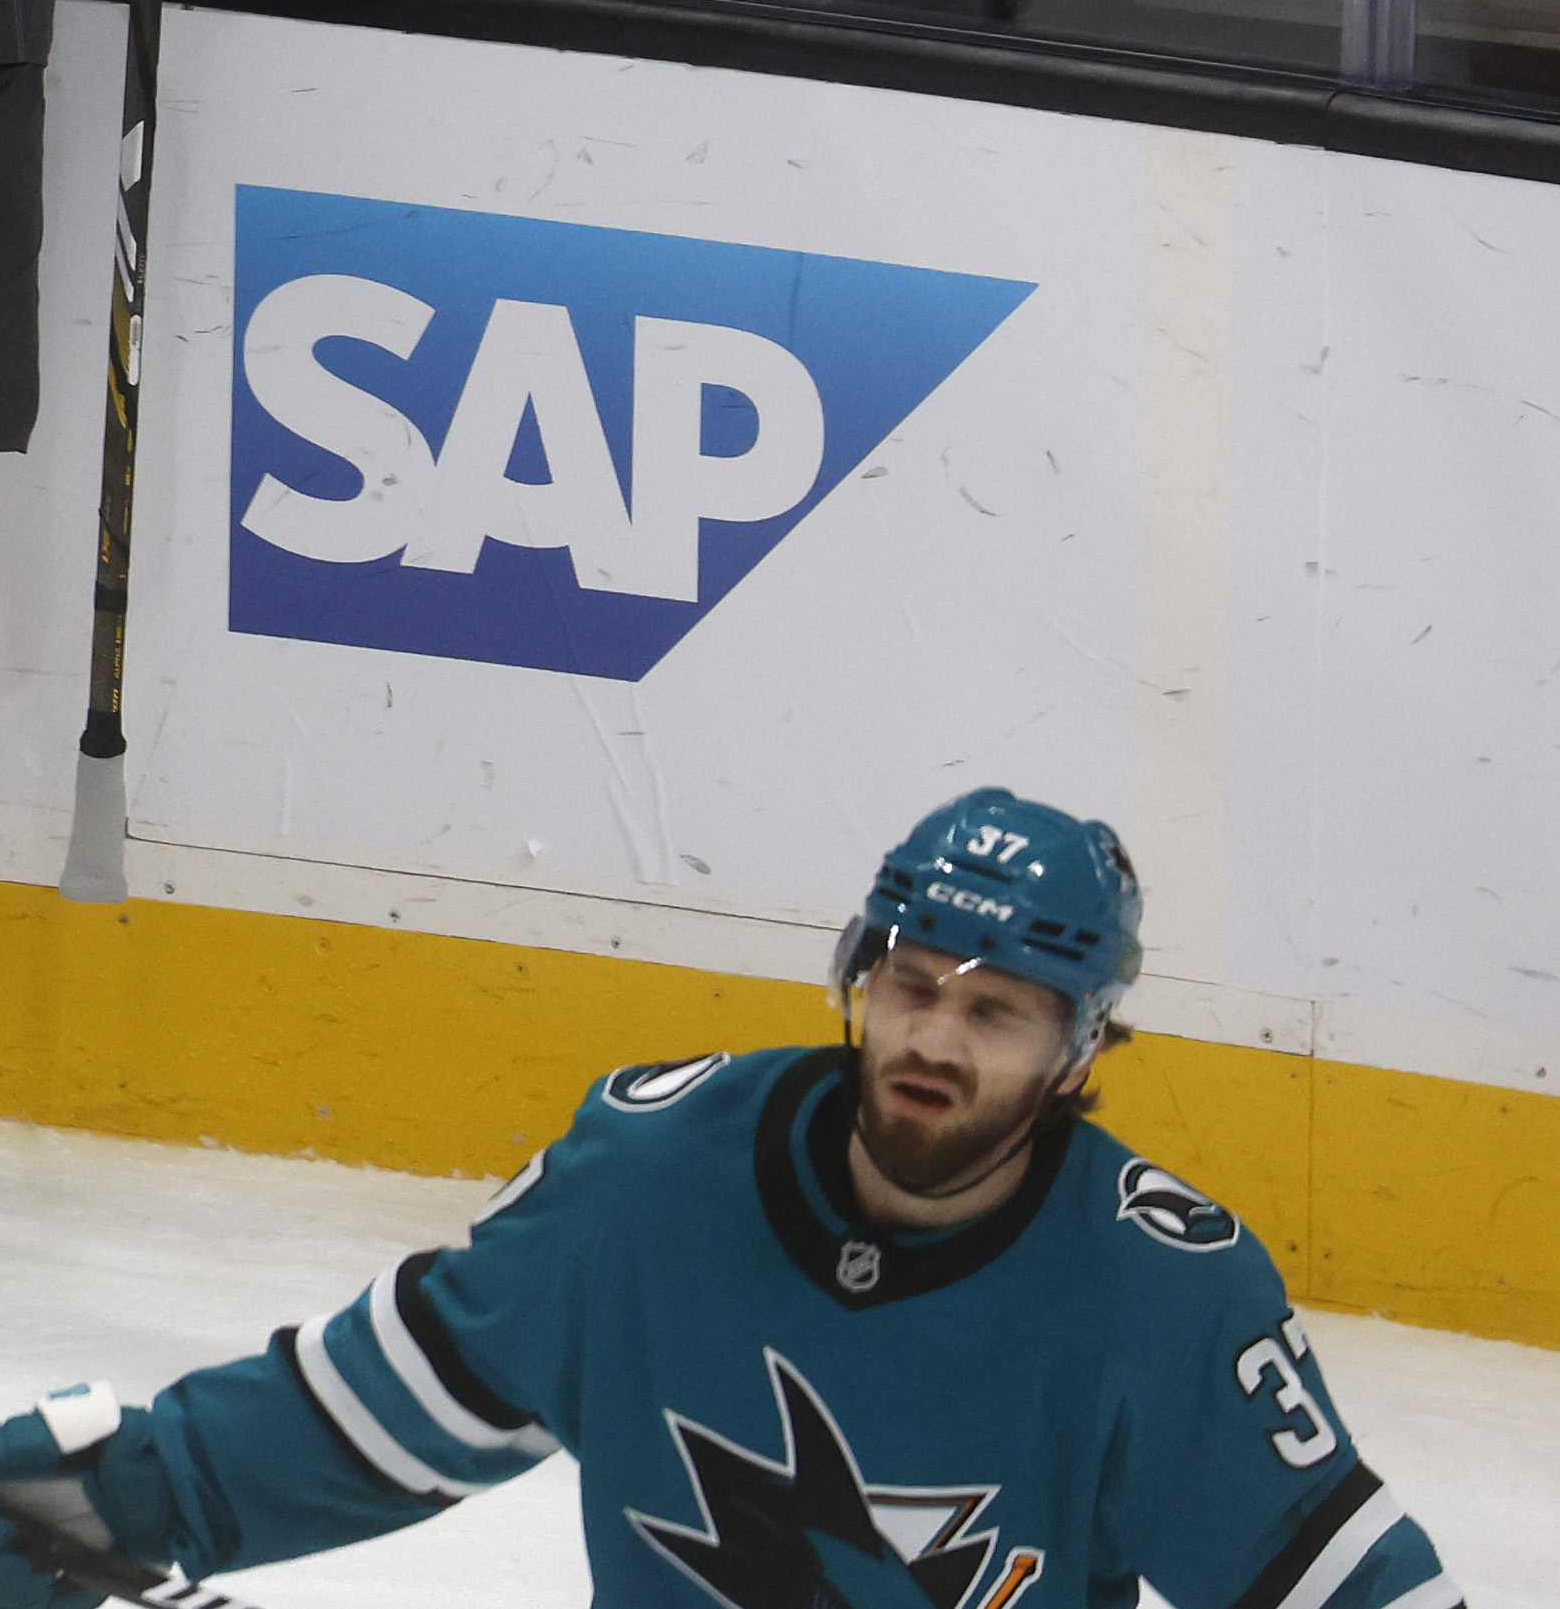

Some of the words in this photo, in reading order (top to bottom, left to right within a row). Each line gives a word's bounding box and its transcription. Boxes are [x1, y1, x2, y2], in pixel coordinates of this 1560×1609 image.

[241, 273, 825, 603] SAP
[966, 824, 1031, 864] 37
[926, 881, 1015, 923] CCM
